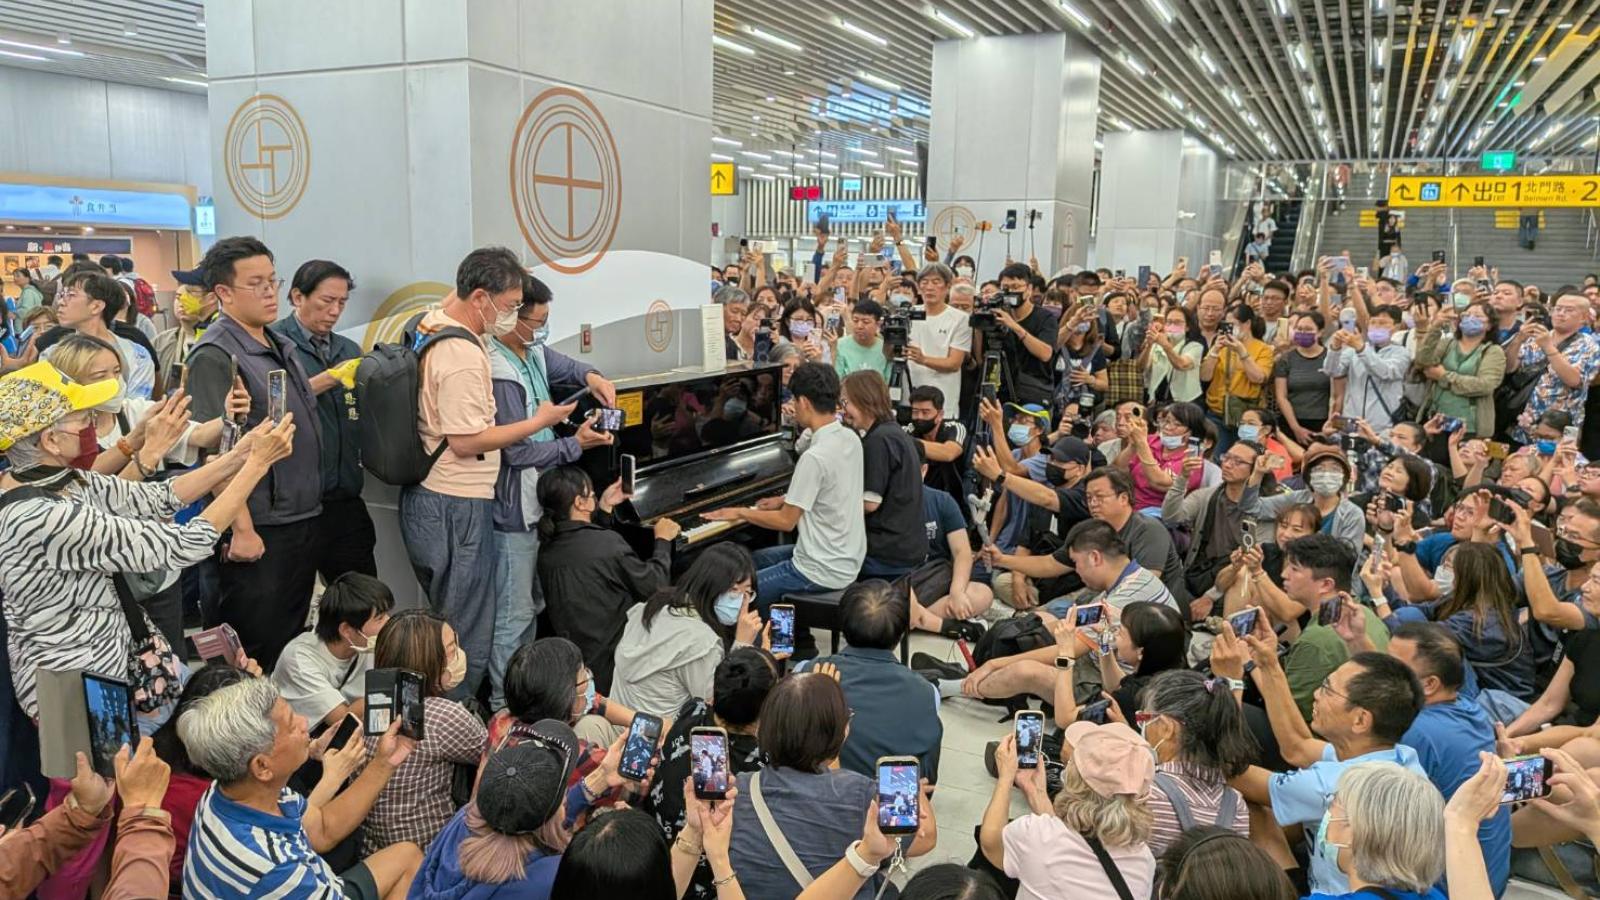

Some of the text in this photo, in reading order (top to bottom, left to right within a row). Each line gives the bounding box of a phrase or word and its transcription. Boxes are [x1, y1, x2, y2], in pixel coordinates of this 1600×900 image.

[1473, 180, 1599, 202] 出口 1 北門路 2
